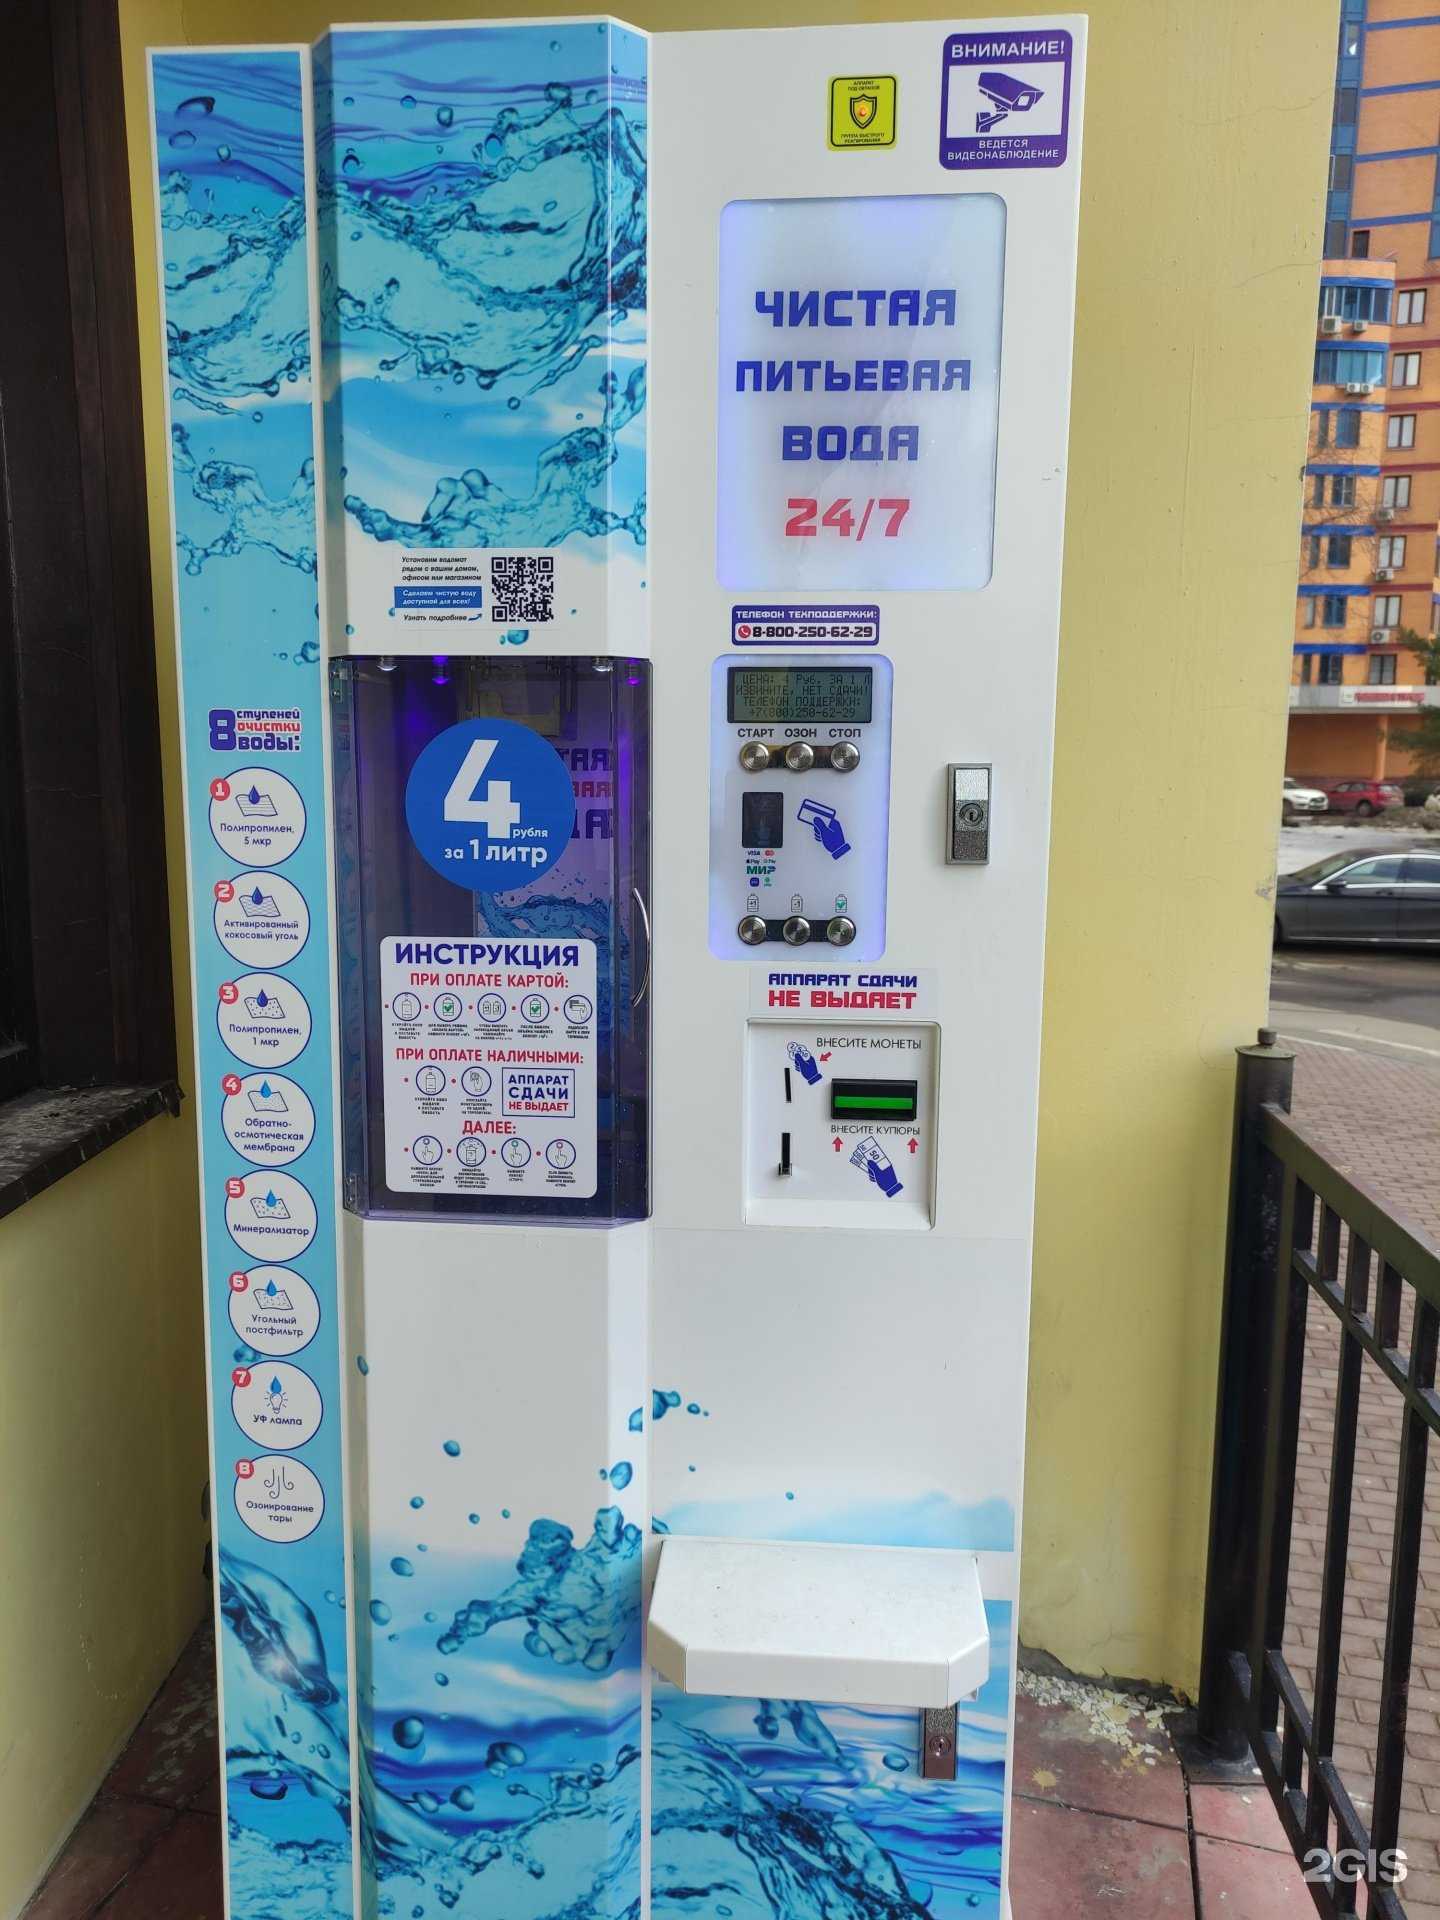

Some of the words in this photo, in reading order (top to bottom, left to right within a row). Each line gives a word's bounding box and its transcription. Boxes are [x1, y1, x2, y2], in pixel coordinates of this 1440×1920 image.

[951, 40, 1065, 59] ВНИМАНИЕ!
[978, 139, 1029, 149] ВЕДЕТСЯ
[947, 149, 1059, 161] ВИДЕОНАБЛЮДЕНИЕ
[755, 289, 956, 327] ЧИСТАЯ
[735, 359, 971, 392] ПИТЬЕВАЯ
[782, 425, 919, 461] ВОДА
[785, 498, 910, 541] 24/7
[736, 611, 784, 619] ТЕЛЕФОН
[788, 610, 877, 619] ТЕХПОДДЕРЖКИ:
[752, 626, 873, 638] 8-800-250-62-29
[802, 685, 823, 695] НЕТ
[744, 696, 789, 706] ТЕЛЕФОН
[237, 709, 300, 720] ступеней
[208, 709, 236, 750] 8
[237, 722, 300, 731] очистки
[738, 728, 774, 738] СТАРТ
[784, 728, 817, 737] ОЗОН
[829, 728, 861, 737] СТОП
[238, 733, 300, 750] воды:
[216, 782, 224, 796] 1
[444, 739, 521, 839] 4
[220, 823, 294, 834] Полипропилен,
[512, 827, 548, 839] рубля
[244, 837, 249, 845] 5
[253, 837, 272, 847] мкр
[444, 847, 464, 860] за
[469, 839, 480, 860] 1
[486, 846, 548, 868] литр
[746, 866, 776, 874] МИР
[218, 884, 230, 898] 2
[224, 919, 299, 930] Активированный
[224, 931, 272, 940] кокосовый
[275, 933, 298, 942] уголь
[395, 943, 579, 969] ИНСТРУКЦИЯ
[410, 973, 440, 986] ПРИ
[445, 973, 501, 987] ОПЛАТЕ
[507, 972, 569, 988] КАРТОЙ:
[768, 973, 851, 987] АППАРАТ
[857, 974, 918, 988] СДАЧИ
[223, 986, 234, 1000] 3
[768, 990, 800, 1007] НЕ
[810, 990, 917, 1009] ВЫДАЕТ
[229, 1023, 302, 1036] Полипропилен,
[253, 1037, 257, 1045] 1
[260, 1038, 279, 1047] мкр
[816, 1037, 868, 1048] ВНЕСИТЕ
[870, 1038, 922, 1050] МОНЕТЫ
[396, 1048, 424, 1060] ПРИ
[428, 1048, 482, 1062] ОПЛАТЕ
[487, 1050, 584, 1064] НАЛИЧНЫМИ:
[226, 1078, 238, 1091] 4
[508, 1074, 569, 1085] АППАРАТ
[508, 1087, 569, 1100] СДАЧИ
[508, 1101, 522, 1110] НЕ
[525, 1102, 569, 1112] ВЫДАЕТ
[245, 1118, 292, 1129] Обратно-
[462, 1120, 516, 1135] ДАЛЕЕ:
[234, 1131, 304, 1141] осмотическая
[831, 1125, 874, 1135] ВНЕСИТЕ
[876, 1125, 920, 1136] КУПЮРЫ
[243, 1142, 295, 1152] мембрана
[870, 1150, 879, 1160] 50
[229, 1181, 241, 1194] 5
[234, 1223, 309, 1236] Минерализатор
[232, 1275, 244, 1289] 6
[252, 1314, 297, 1325] Угольный
[245, 1326, 304, 1337] постфильтр
[236, 1371, 247, 1385] 7
[253, 1414, 268, 1425] УФ
[270, 1416, 303, 1426] лампа
[239, 1462, 250, 1476] 8
[246, 1500, 314, 1513] Озонирование
[268, 1514, 292, 1523] тары
